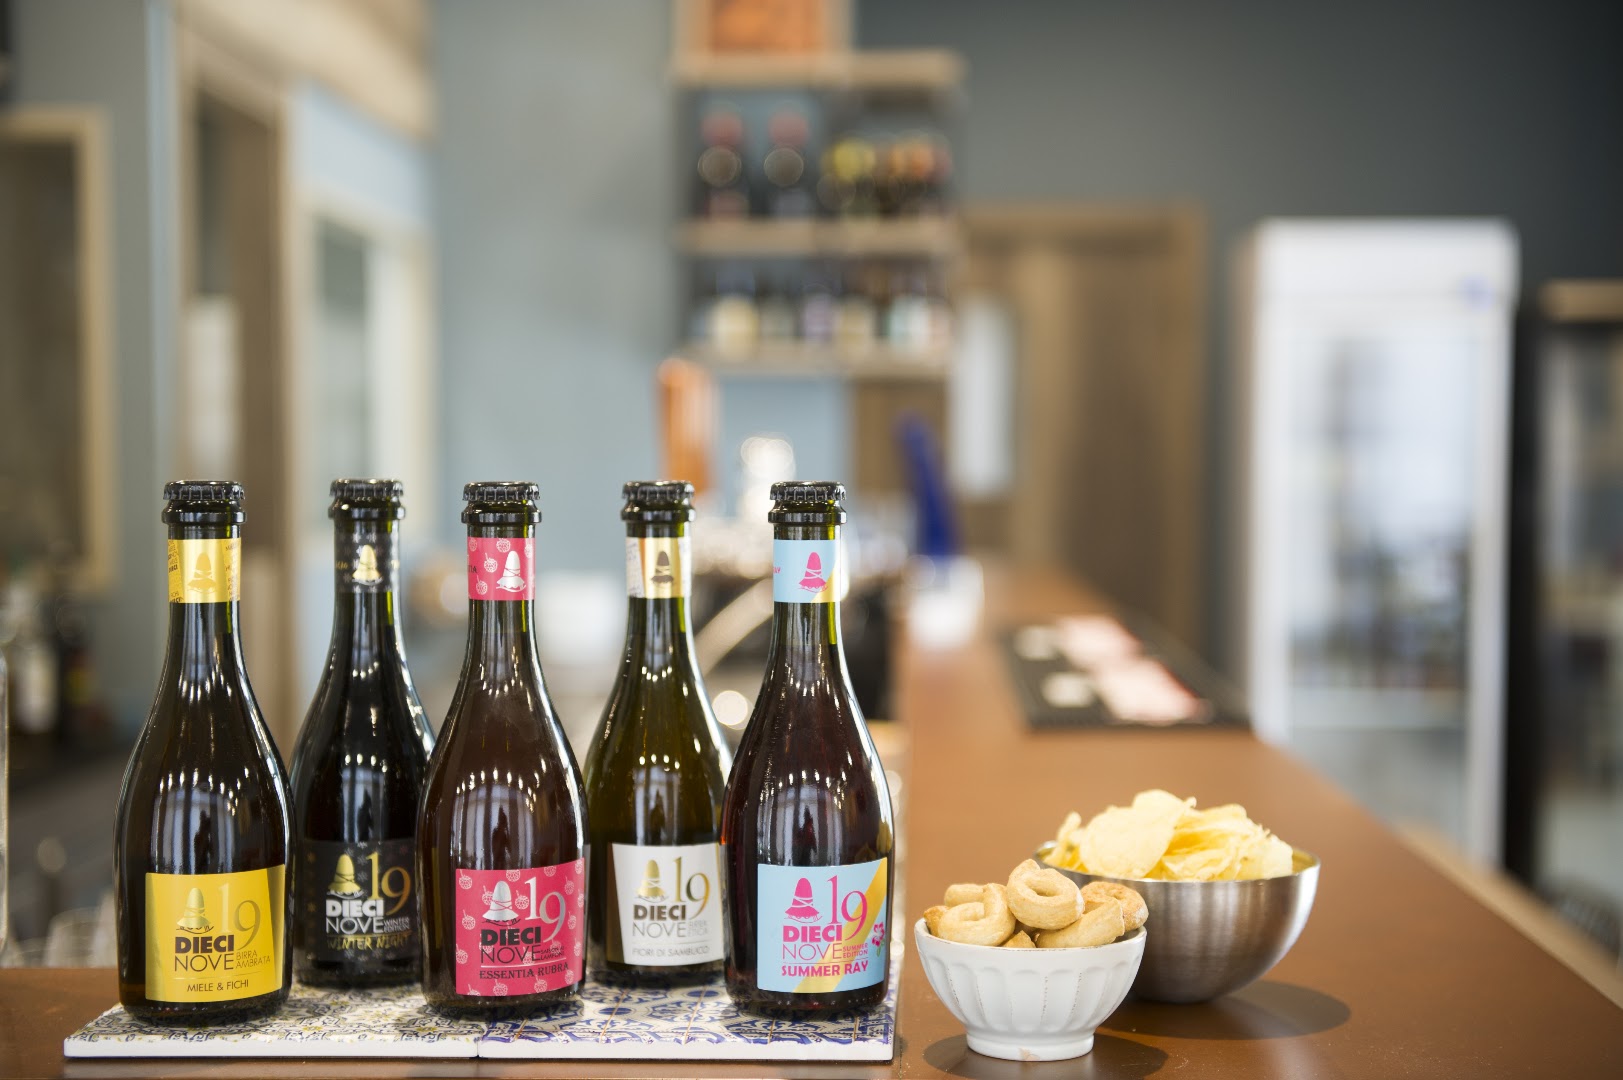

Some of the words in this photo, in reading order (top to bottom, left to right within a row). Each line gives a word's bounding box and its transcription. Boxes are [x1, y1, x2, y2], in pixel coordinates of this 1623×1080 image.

[366, 851, 411, 916] 19
[673, 856, 711, 920] 19
[218, 882, 261, 950] 19
[326, 899, 384, 918] DIECI
[524, 876, 566, 943] 19
[633, 904, 687, 921] DIECI
[827, 874, 868, 941] 19
[326, 917, 384, 935] NOVE
[632, 921, 687, 939] NOVE
[782, 924, 843, 943] DIECI
[175, 934, 235, 954] DIECI
[327, 936, 373, 950] WINTER
[480, 926, 542, 946] DIECI
[236, 950, 258, 961] BIRRA
[480, 944, 542, 964] NOVE
[632, 947, 654, 958] FIORI
[656, 947, 665, 957] DI
[668, 945, 710, 957] SAMBUCO
[782, 942, 843, 961] NOVE
[843, 943, 868, 952] SUMMER
[843, 950, 868, 959] EDITION
[174, 953, 234, 972] NOVE
[236, 956, 271, 969] AMBRATA
[480, 968, 535, 980] ESSENTIA
[537, 962, 569, 977] RUBRA
[781, 964, 840, 977] SUMMER
[844, 960, 869, 975] RAY
[187, 982, 214, 993] MIELE
[216, 982, 224, 991] &
[226, 979, 249, 990] FICHI
